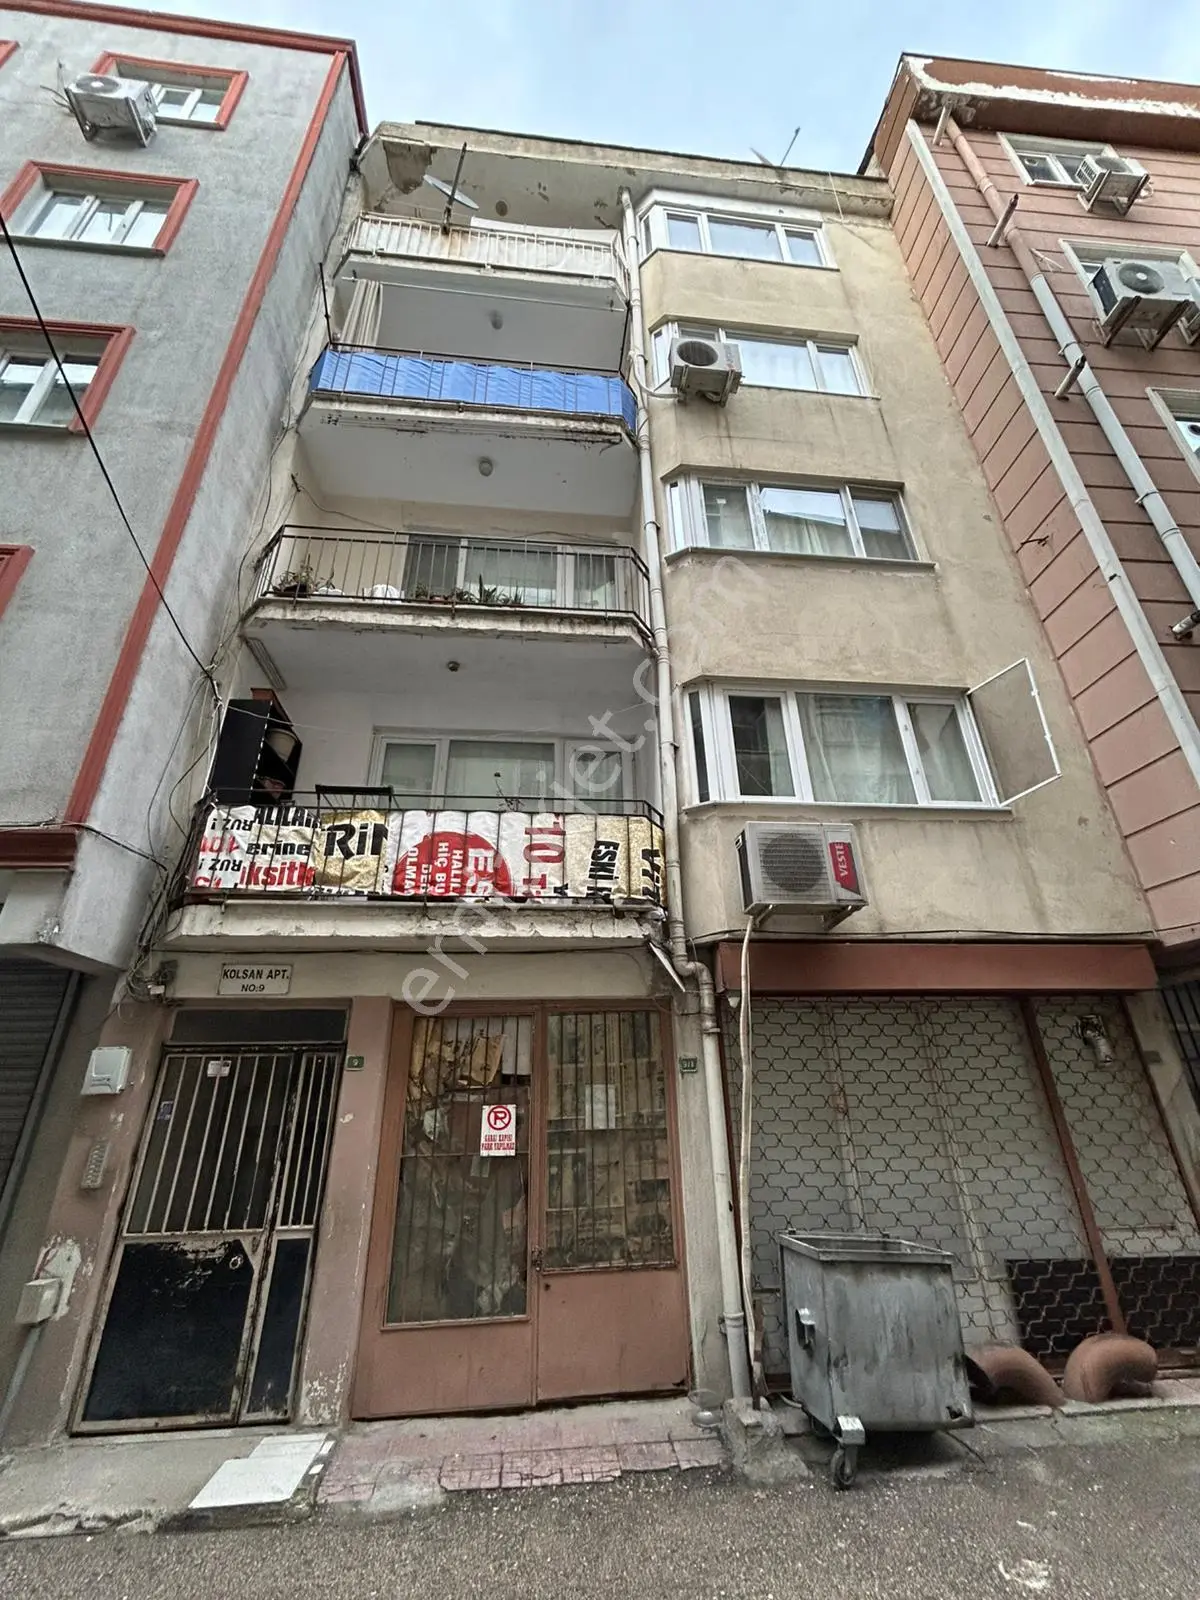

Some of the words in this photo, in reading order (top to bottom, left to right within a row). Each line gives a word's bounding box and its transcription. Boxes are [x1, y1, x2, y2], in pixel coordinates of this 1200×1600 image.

[588, 840, 620, 881] ESKİ
[222, 968, 263, 980] KOLSAN
[266, 969, 290, 980] APT.
[240, 984, 265, 993] NO:9
